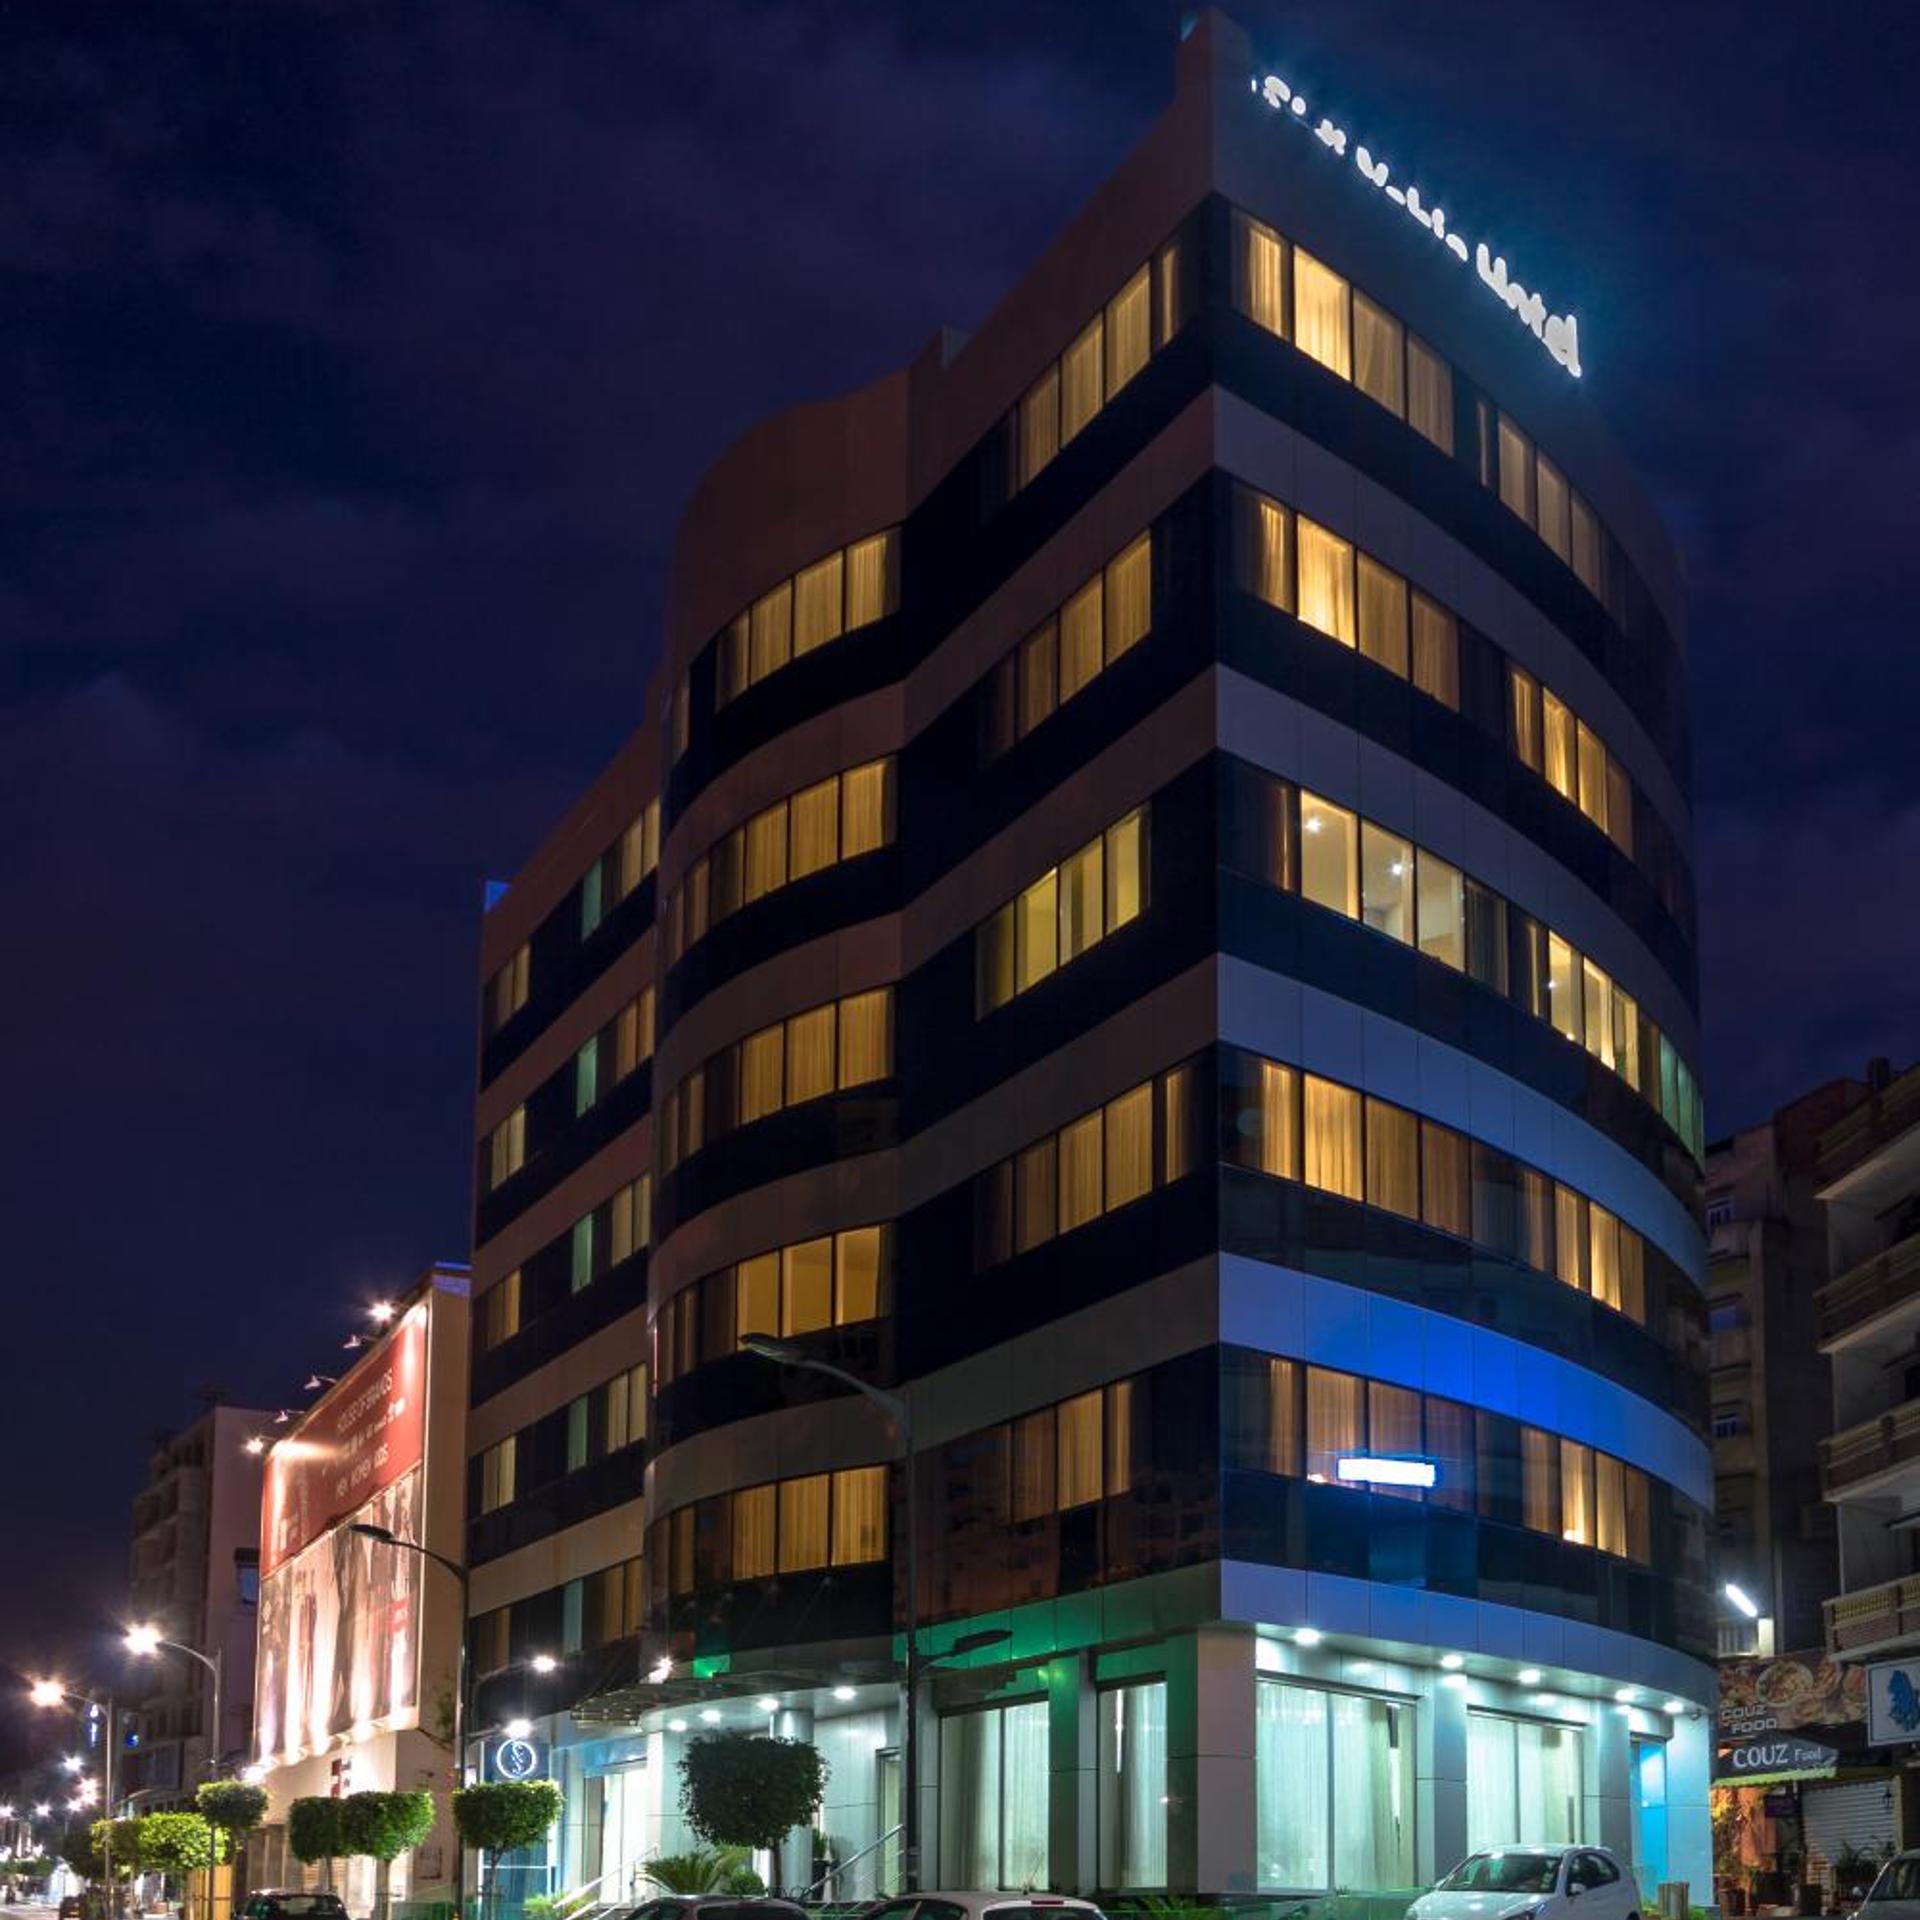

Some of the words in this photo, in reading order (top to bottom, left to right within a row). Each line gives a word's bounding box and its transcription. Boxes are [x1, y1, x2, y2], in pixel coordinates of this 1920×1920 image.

[1722, 1704, 1766, 1719] COUZ
[1732, 1719, 1777, 1734] FOOD
[1733, 1745, 1788, 1767] COUZ
[1796, 1748, 1822, 1761] Food
